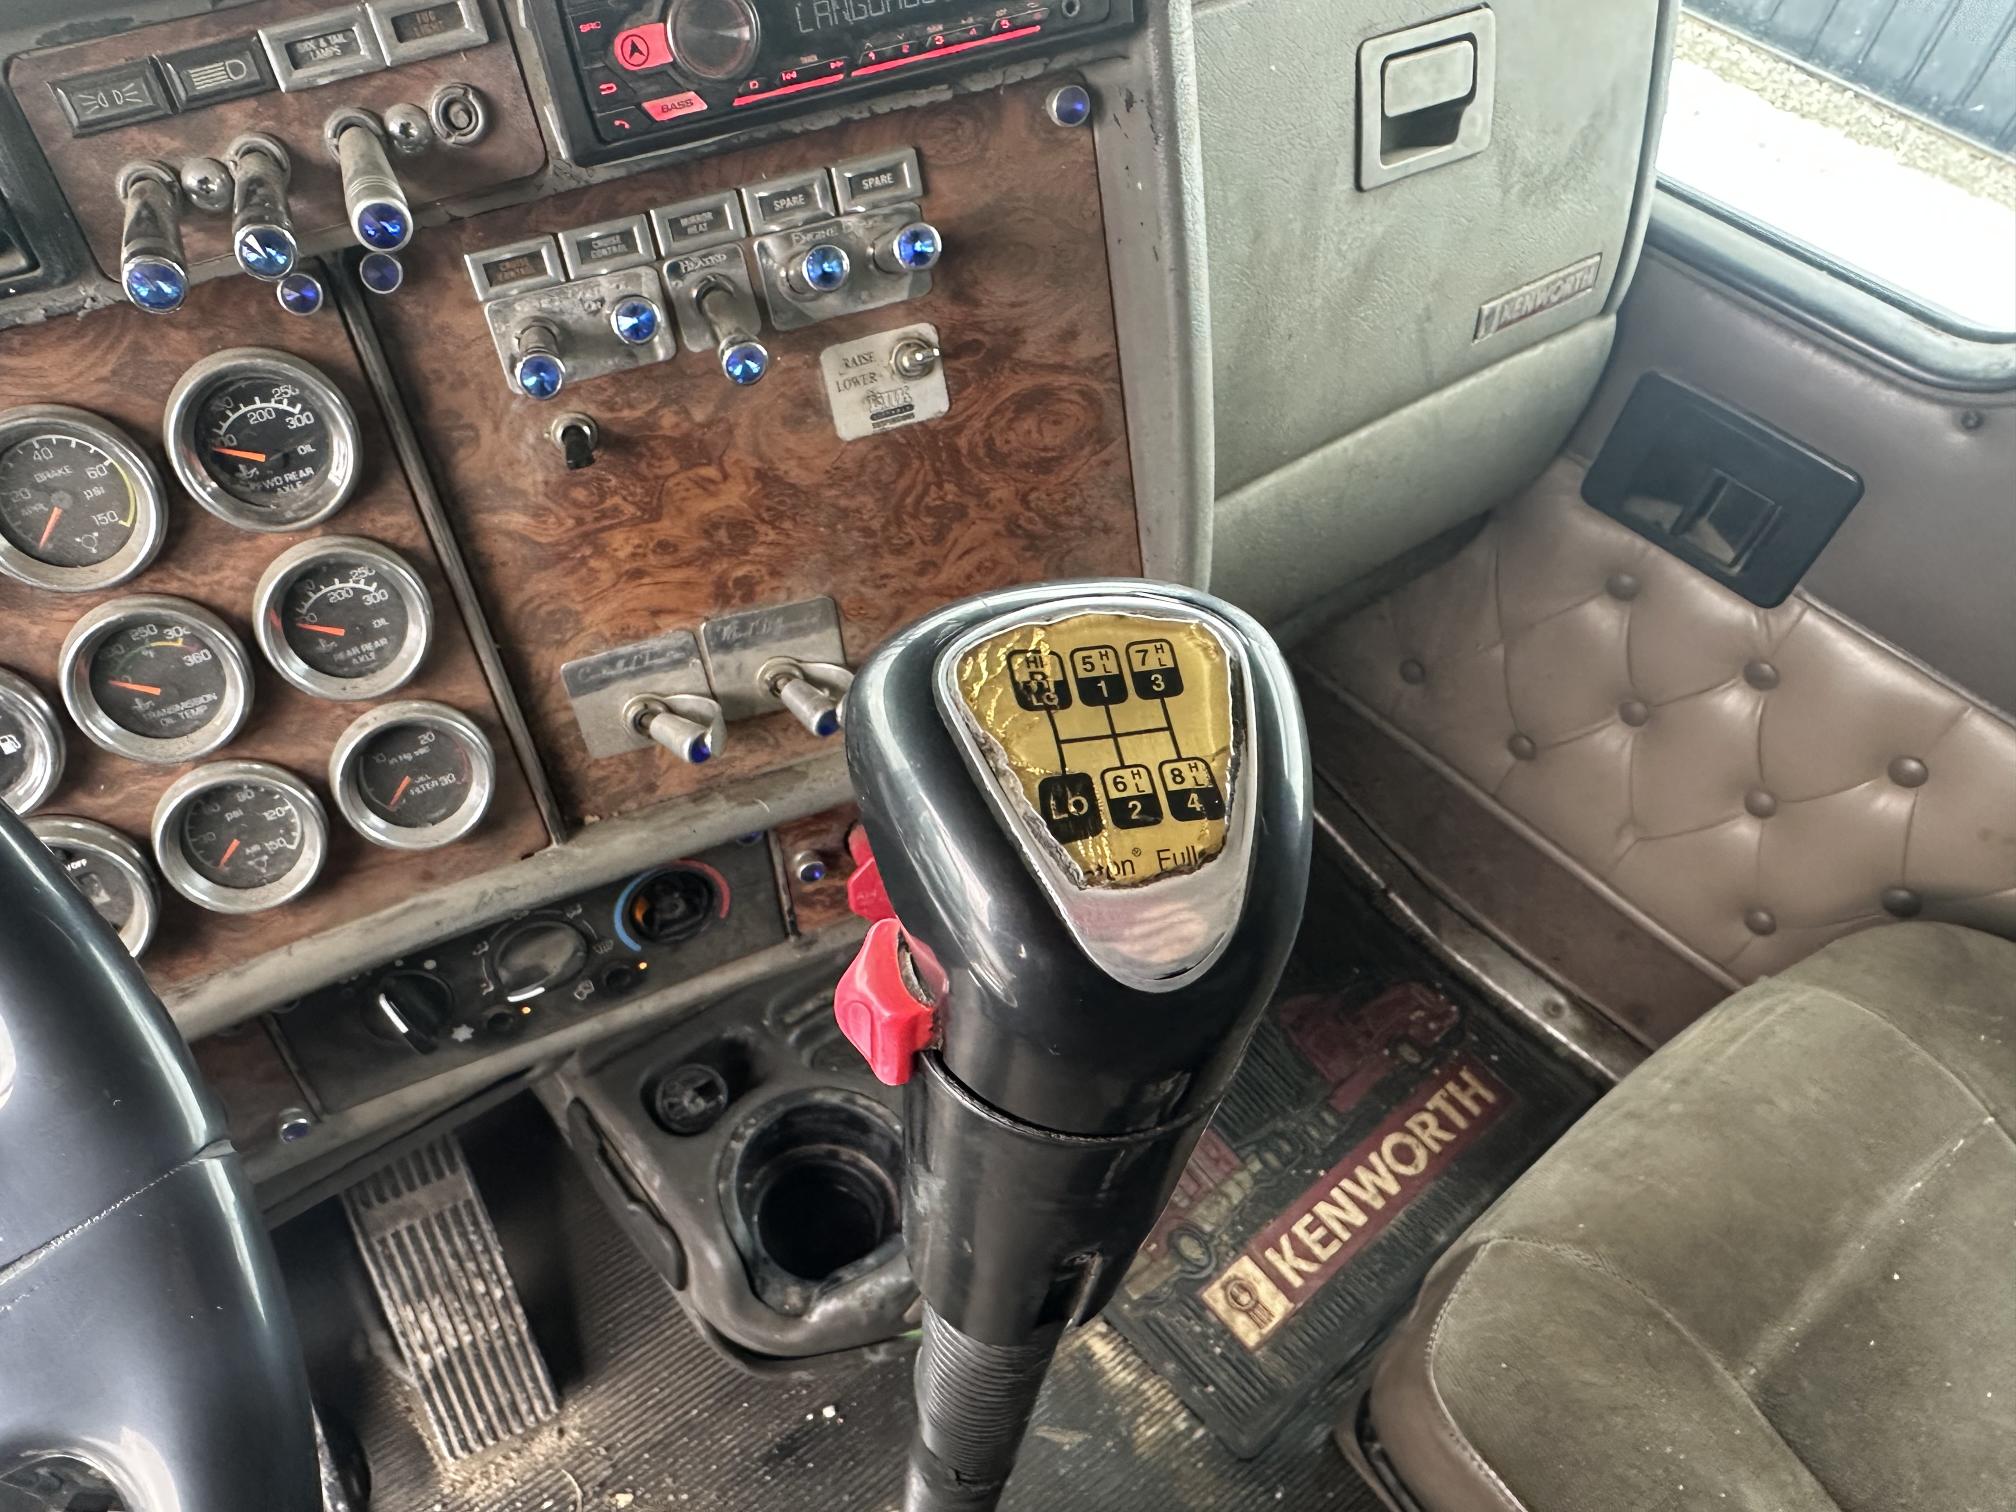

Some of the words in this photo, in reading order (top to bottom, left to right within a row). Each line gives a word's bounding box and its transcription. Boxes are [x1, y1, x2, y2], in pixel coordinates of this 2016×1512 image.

[661, 98, 693, 113] BASS
[861, 172, 895, 190] SPARE
[773, 194, 806, 212] SPARE
[1501, 264, 1597, 324] KENWORTH
[836, 371, 878, 393] LOWER
[247, 407, 276, 425] 200
[285, 411, 315, 430] 300
[33, 446, 54, 462] 40
[296, 444, 317, 455] OIL
[34, 464, 74, 484] BRAKE
[86, 463, 108, 480] 60
[284, 466, 315, 484] REAR
[276, 480, 304, 495] AXLE
[91, 510, 120, 527] 150
[327, 587, 354, 603] 200
[362, 589, 389, 606] 300
[129, 623, 159, 642] 250
[361, 637, 389, 653] REAR
[1154, 644, 1165, 655] H
[182, 648, 213, 667] 360
[1026, 656, 1045, 669] HI
[1100, 650, 1110, 661] H
[1135, 648, 1149, 667] 7
[1158, 656, 1168, 668] L
[1081, 655, 1096, 674] 5
[1104, 663, 1113, 674] L
[1097, 680, 1109, 698] 1
[1150, 673, 1166, 692] 3
[178, 704, 209, 720] TEMP
[418, 731, 436, 745] 20
[1131, 769, 1143, 780] H
[1170, 767, 1186, 785] 8
[1187, 762, 1199, 773] H
[438, 772, 457, 787] 30
[1112, 775, 1128, 793] 6
[1134, 782, 1146, 794] L
[1194, 775, 1205, 787] L
[1051, 792, 1089, 820] LO
[1127, 800, 1143, 820] 2
[1187, 793, 1203, 812] 4
[262, 806, 286, 821] 120
[1264, 1065, 1496, 1288] KENWORTH
